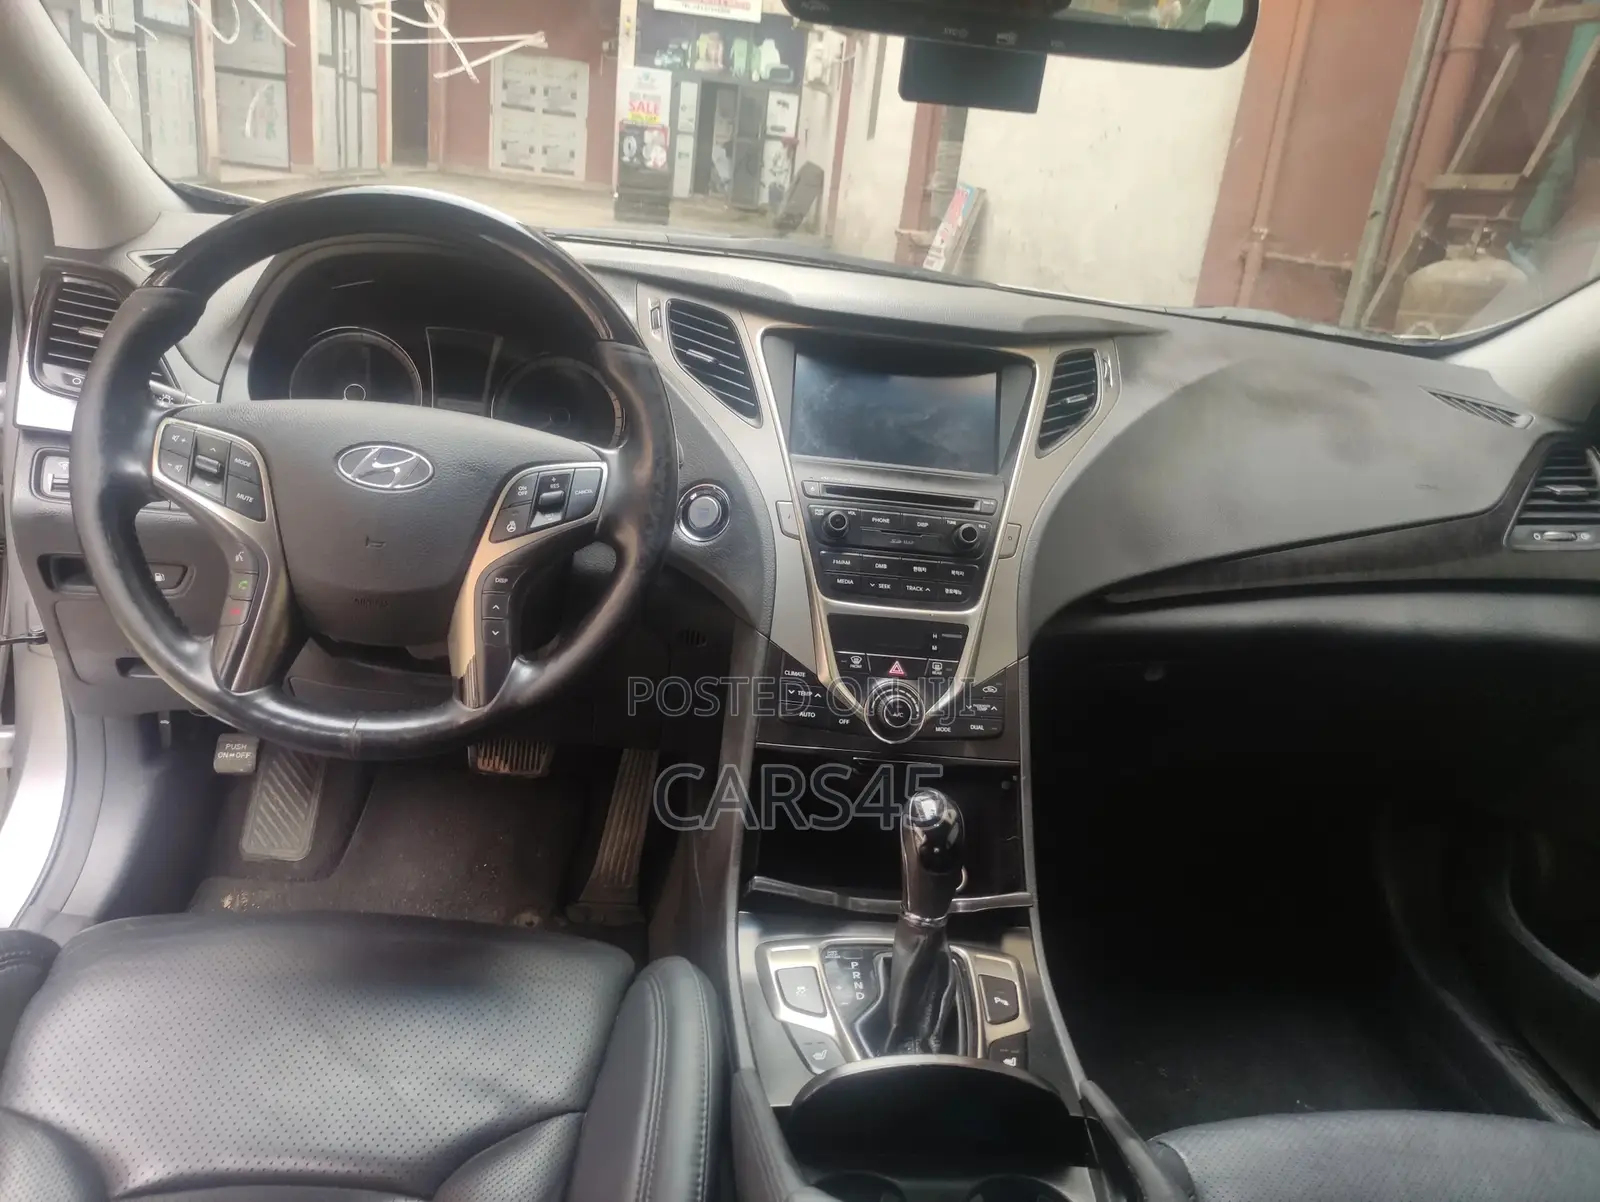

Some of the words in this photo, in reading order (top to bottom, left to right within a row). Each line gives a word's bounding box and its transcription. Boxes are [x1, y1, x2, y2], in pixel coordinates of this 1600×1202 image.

[629, 100, 661, 114] SALE
[234, 457, 252, 468] MODE
[574, 488, 593, 496] CANCEL
[236, 492, 254, 503] MUTE
[874, 562, 888, 570] DMB
[494, 576, 508, 584] DISP
[217, 751, 229, 759] ON
[850, 961, 859, 969] P
[852, 971, 861, 979] R
[853, 981, 864, 990] N
[855, 991, 865, 1001] D
